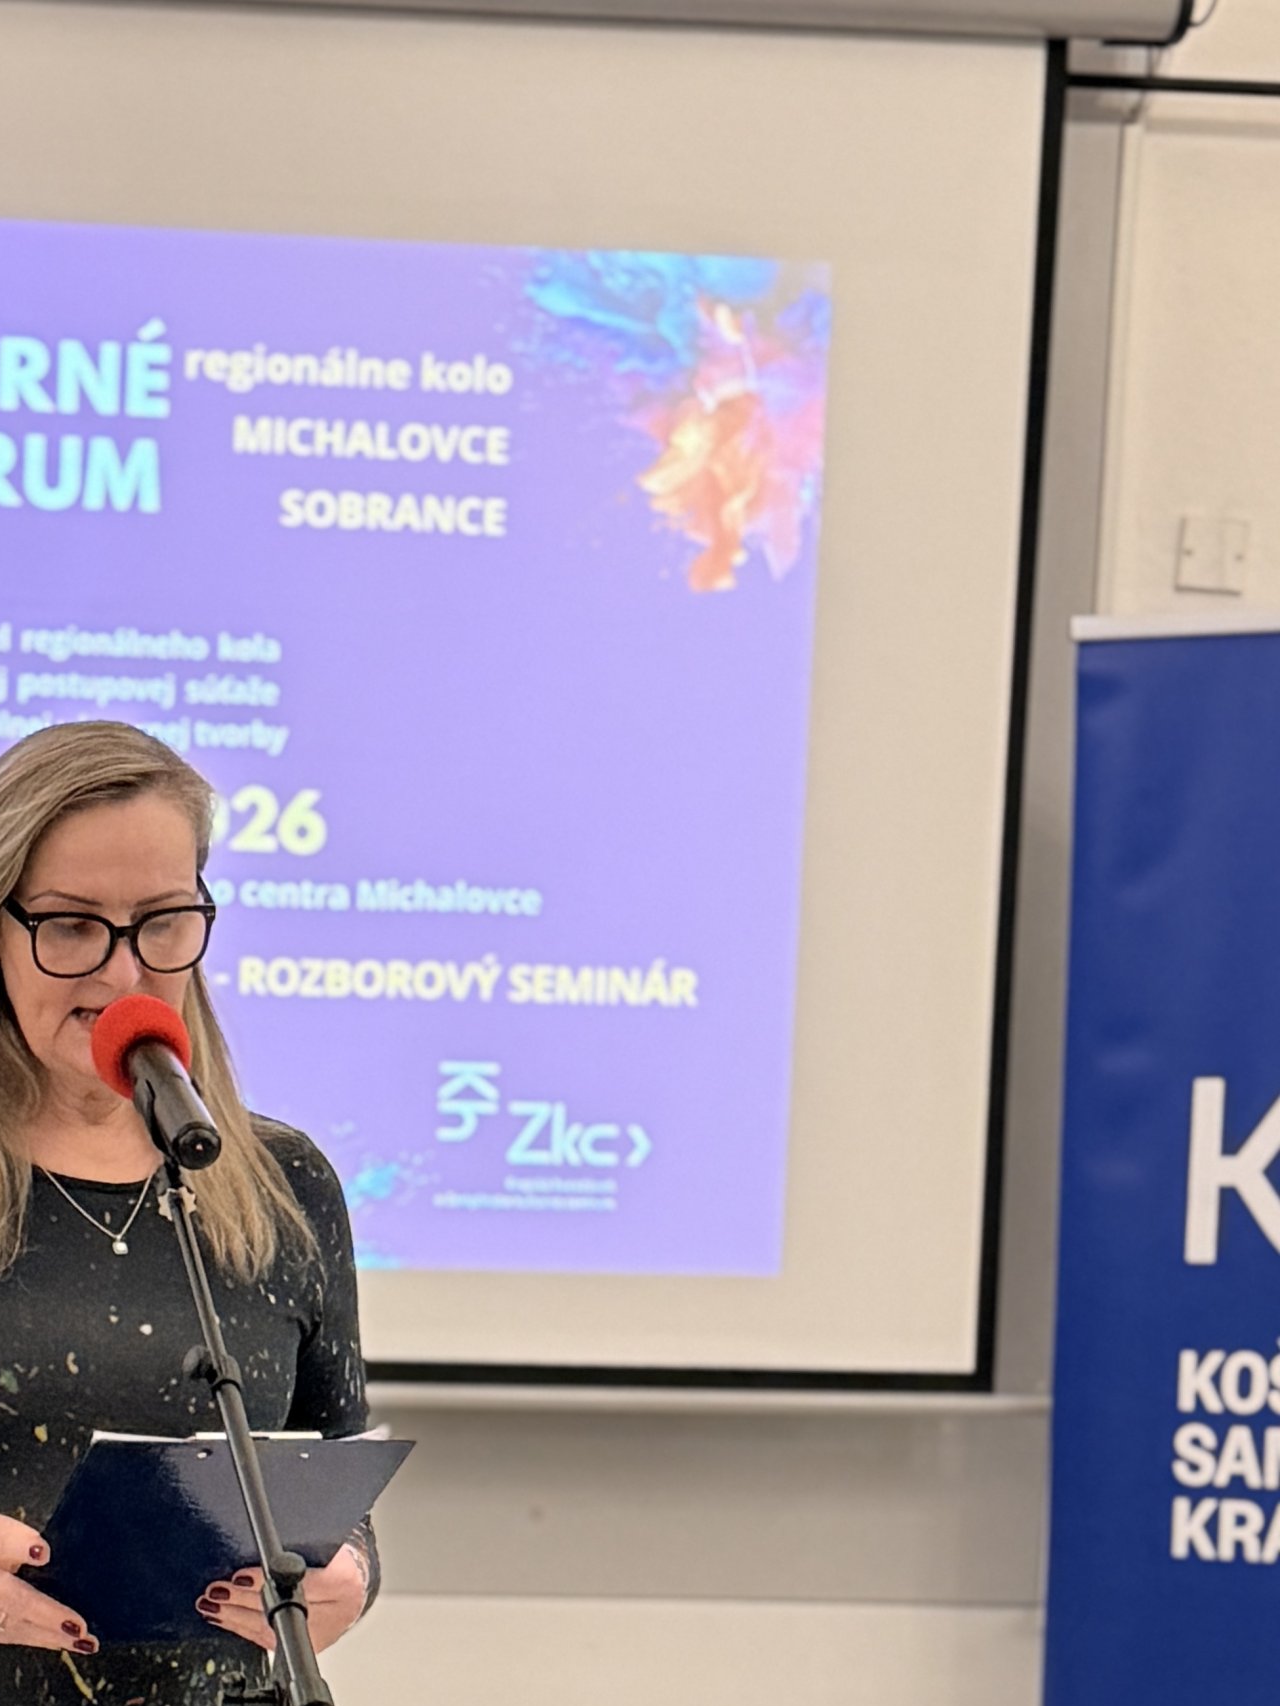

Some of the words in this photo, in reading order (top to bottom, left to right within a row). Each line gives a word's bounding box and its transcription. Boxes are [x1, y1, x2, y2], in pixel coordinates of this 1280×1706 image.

[184, 343, 411, 393] regionálne
[420, 352, 513, 395] kolo
[233, 415, 509, 466] MICHALOVCE
[280, 488, 506, 537] SOBRANCE
[240, 879, 351, 911] centra
[356, 878, 543, 916] Michalovce
[237, 952, 501, 1002] ROZBOROVÝ
[507, 958, 698, 1009] SEMINÁR
